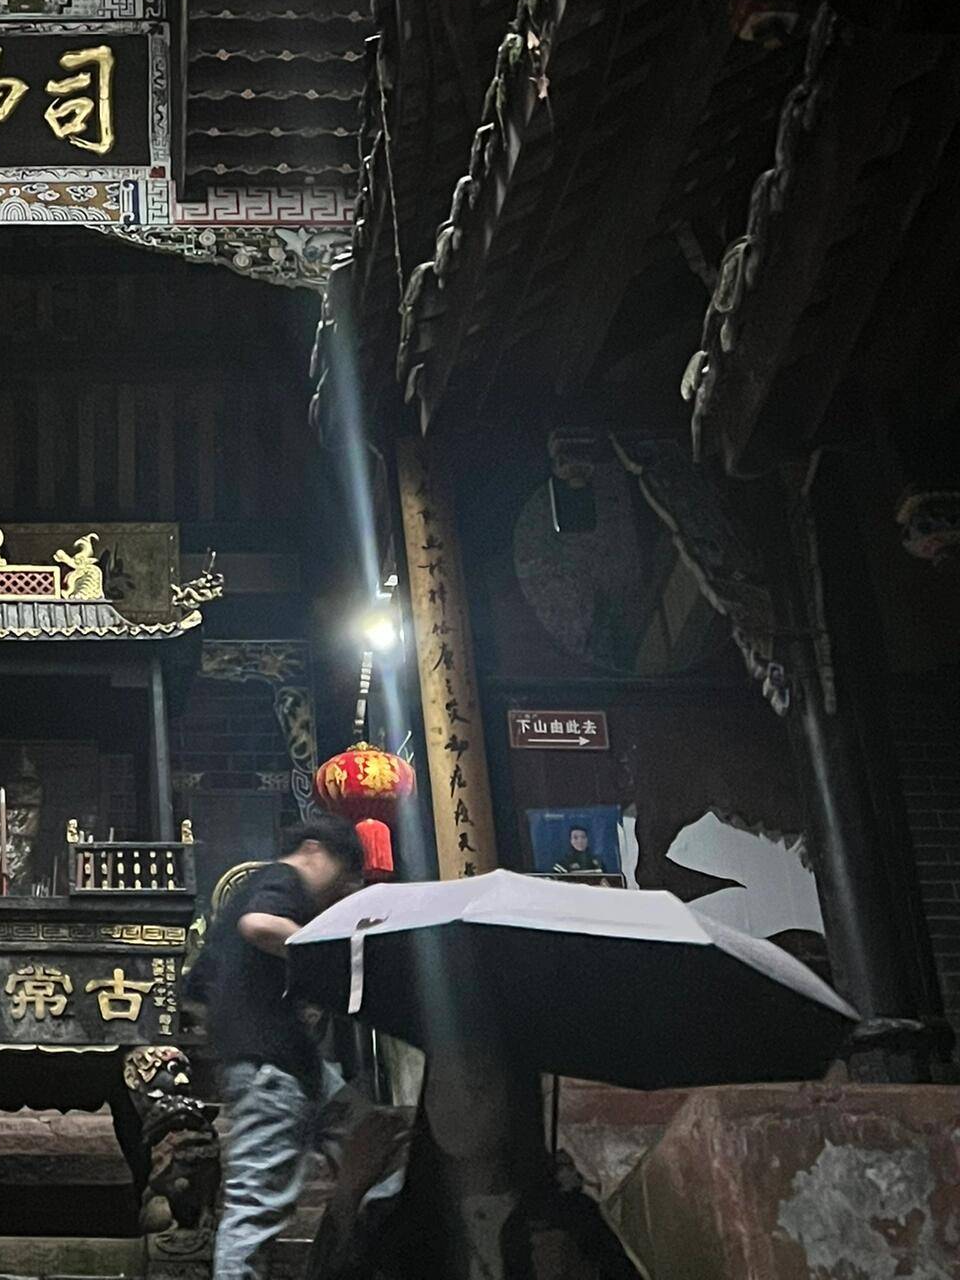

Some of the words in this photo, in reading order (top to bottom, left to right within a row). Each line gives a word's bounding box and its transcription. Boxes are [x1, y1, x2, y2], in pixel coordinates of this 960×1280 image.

[515, 719, 598, 735] 下山由此去
